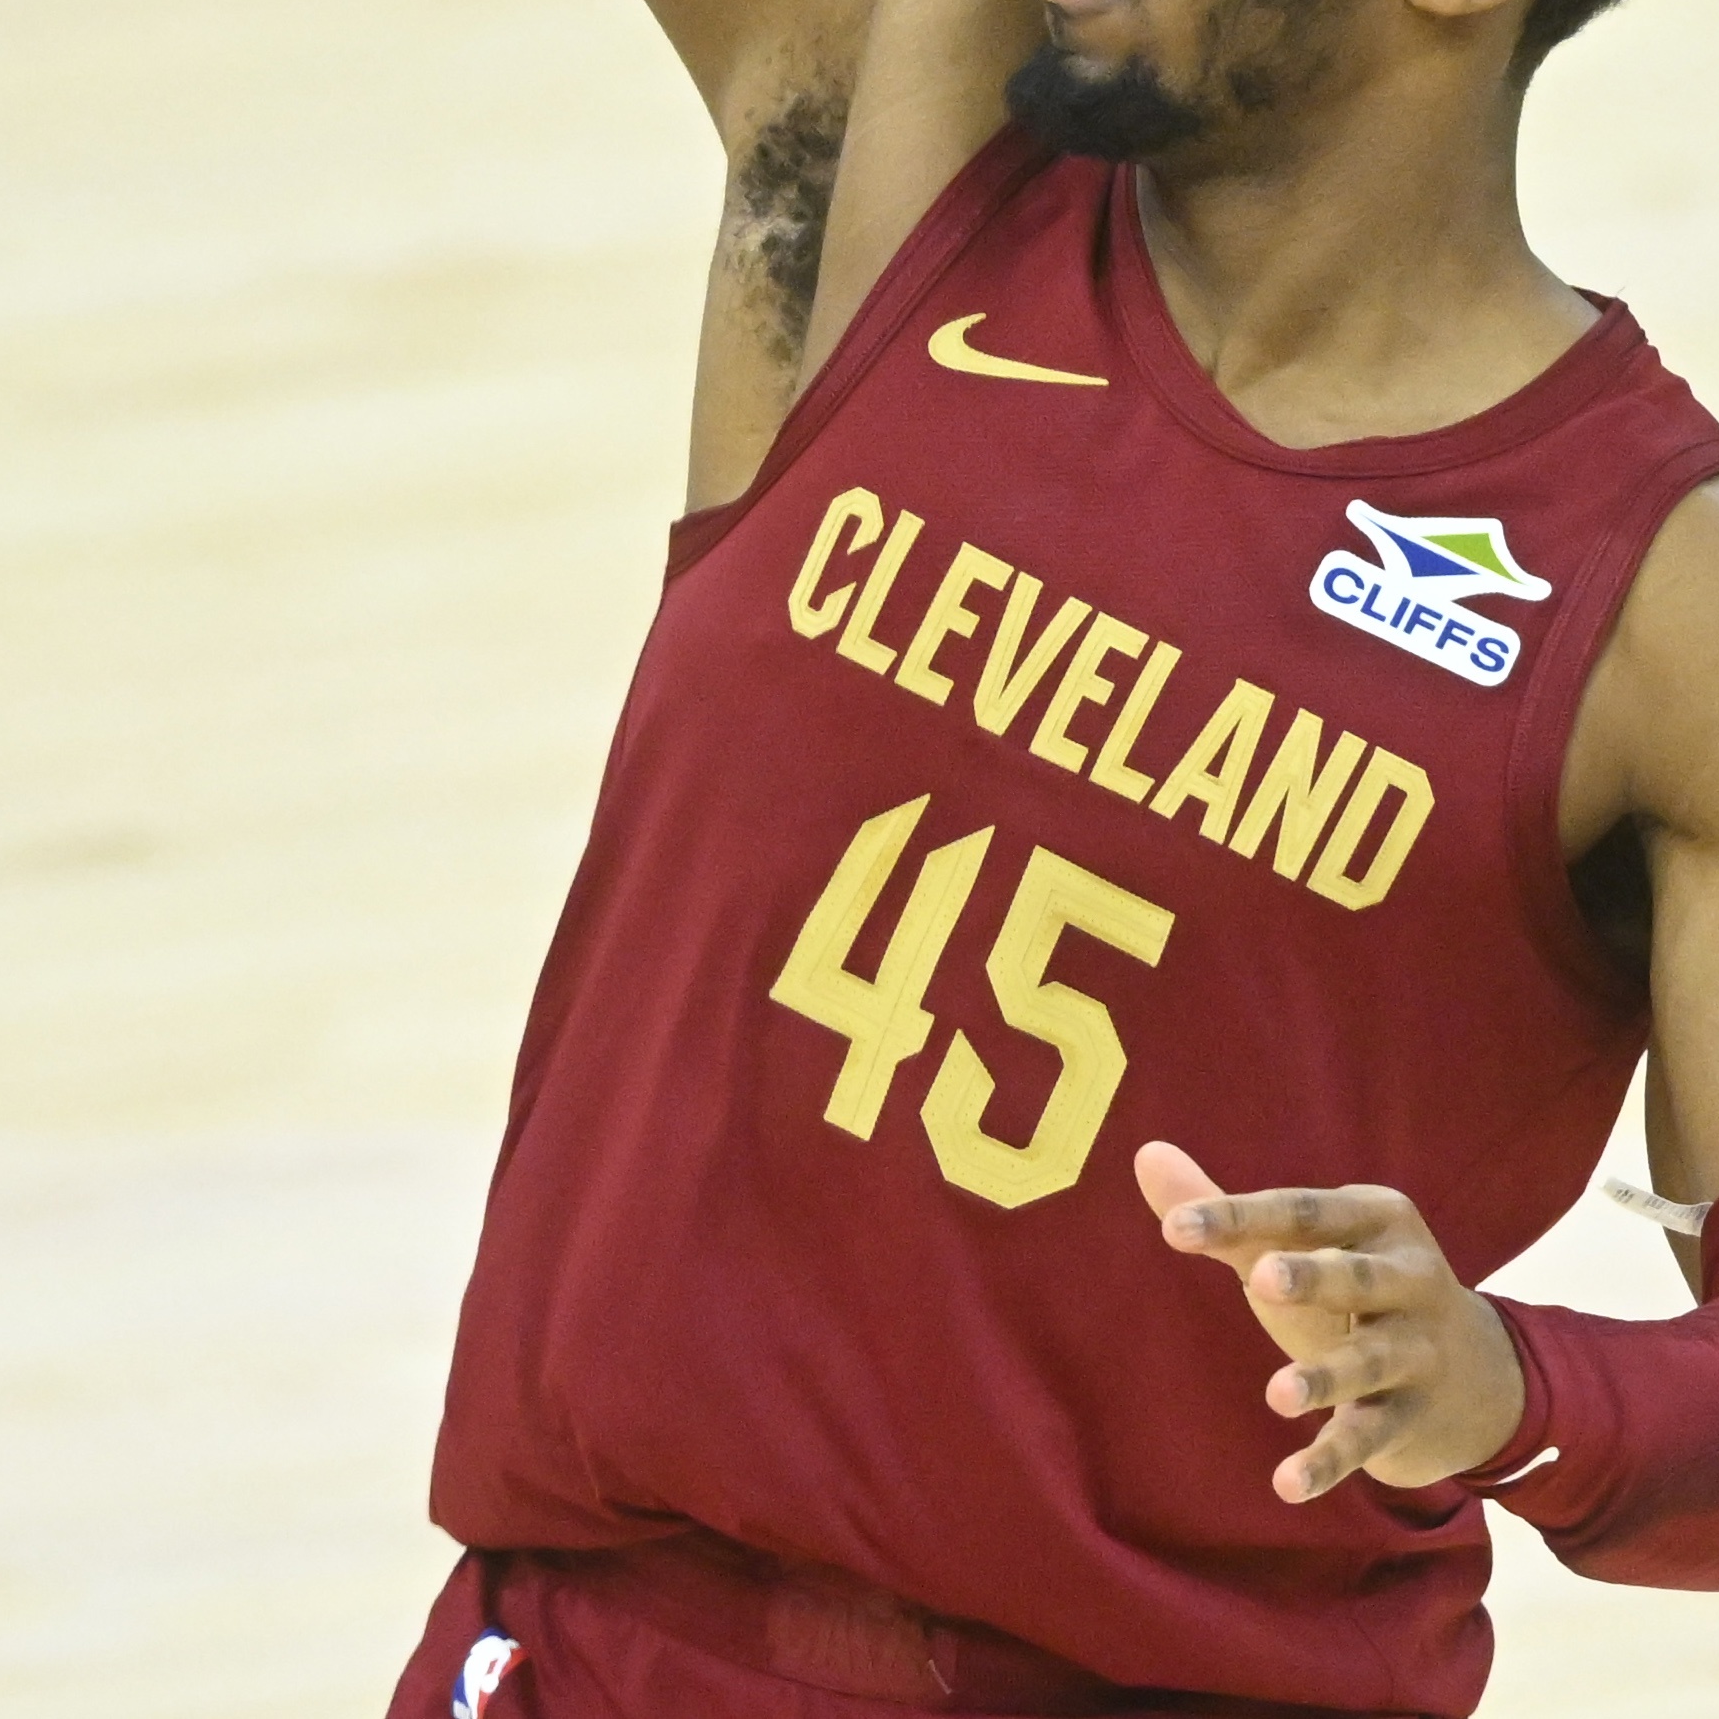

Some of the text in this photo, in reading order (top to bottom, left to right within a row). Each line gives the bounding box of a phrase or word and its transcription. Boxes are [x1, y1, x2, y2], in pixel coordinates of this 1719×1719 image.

[787, 486, 1436, 912] CLEVELAND
[1323, 567, 1510, 673] CLIFFS
[769, 793, 1176, 1210] 45
